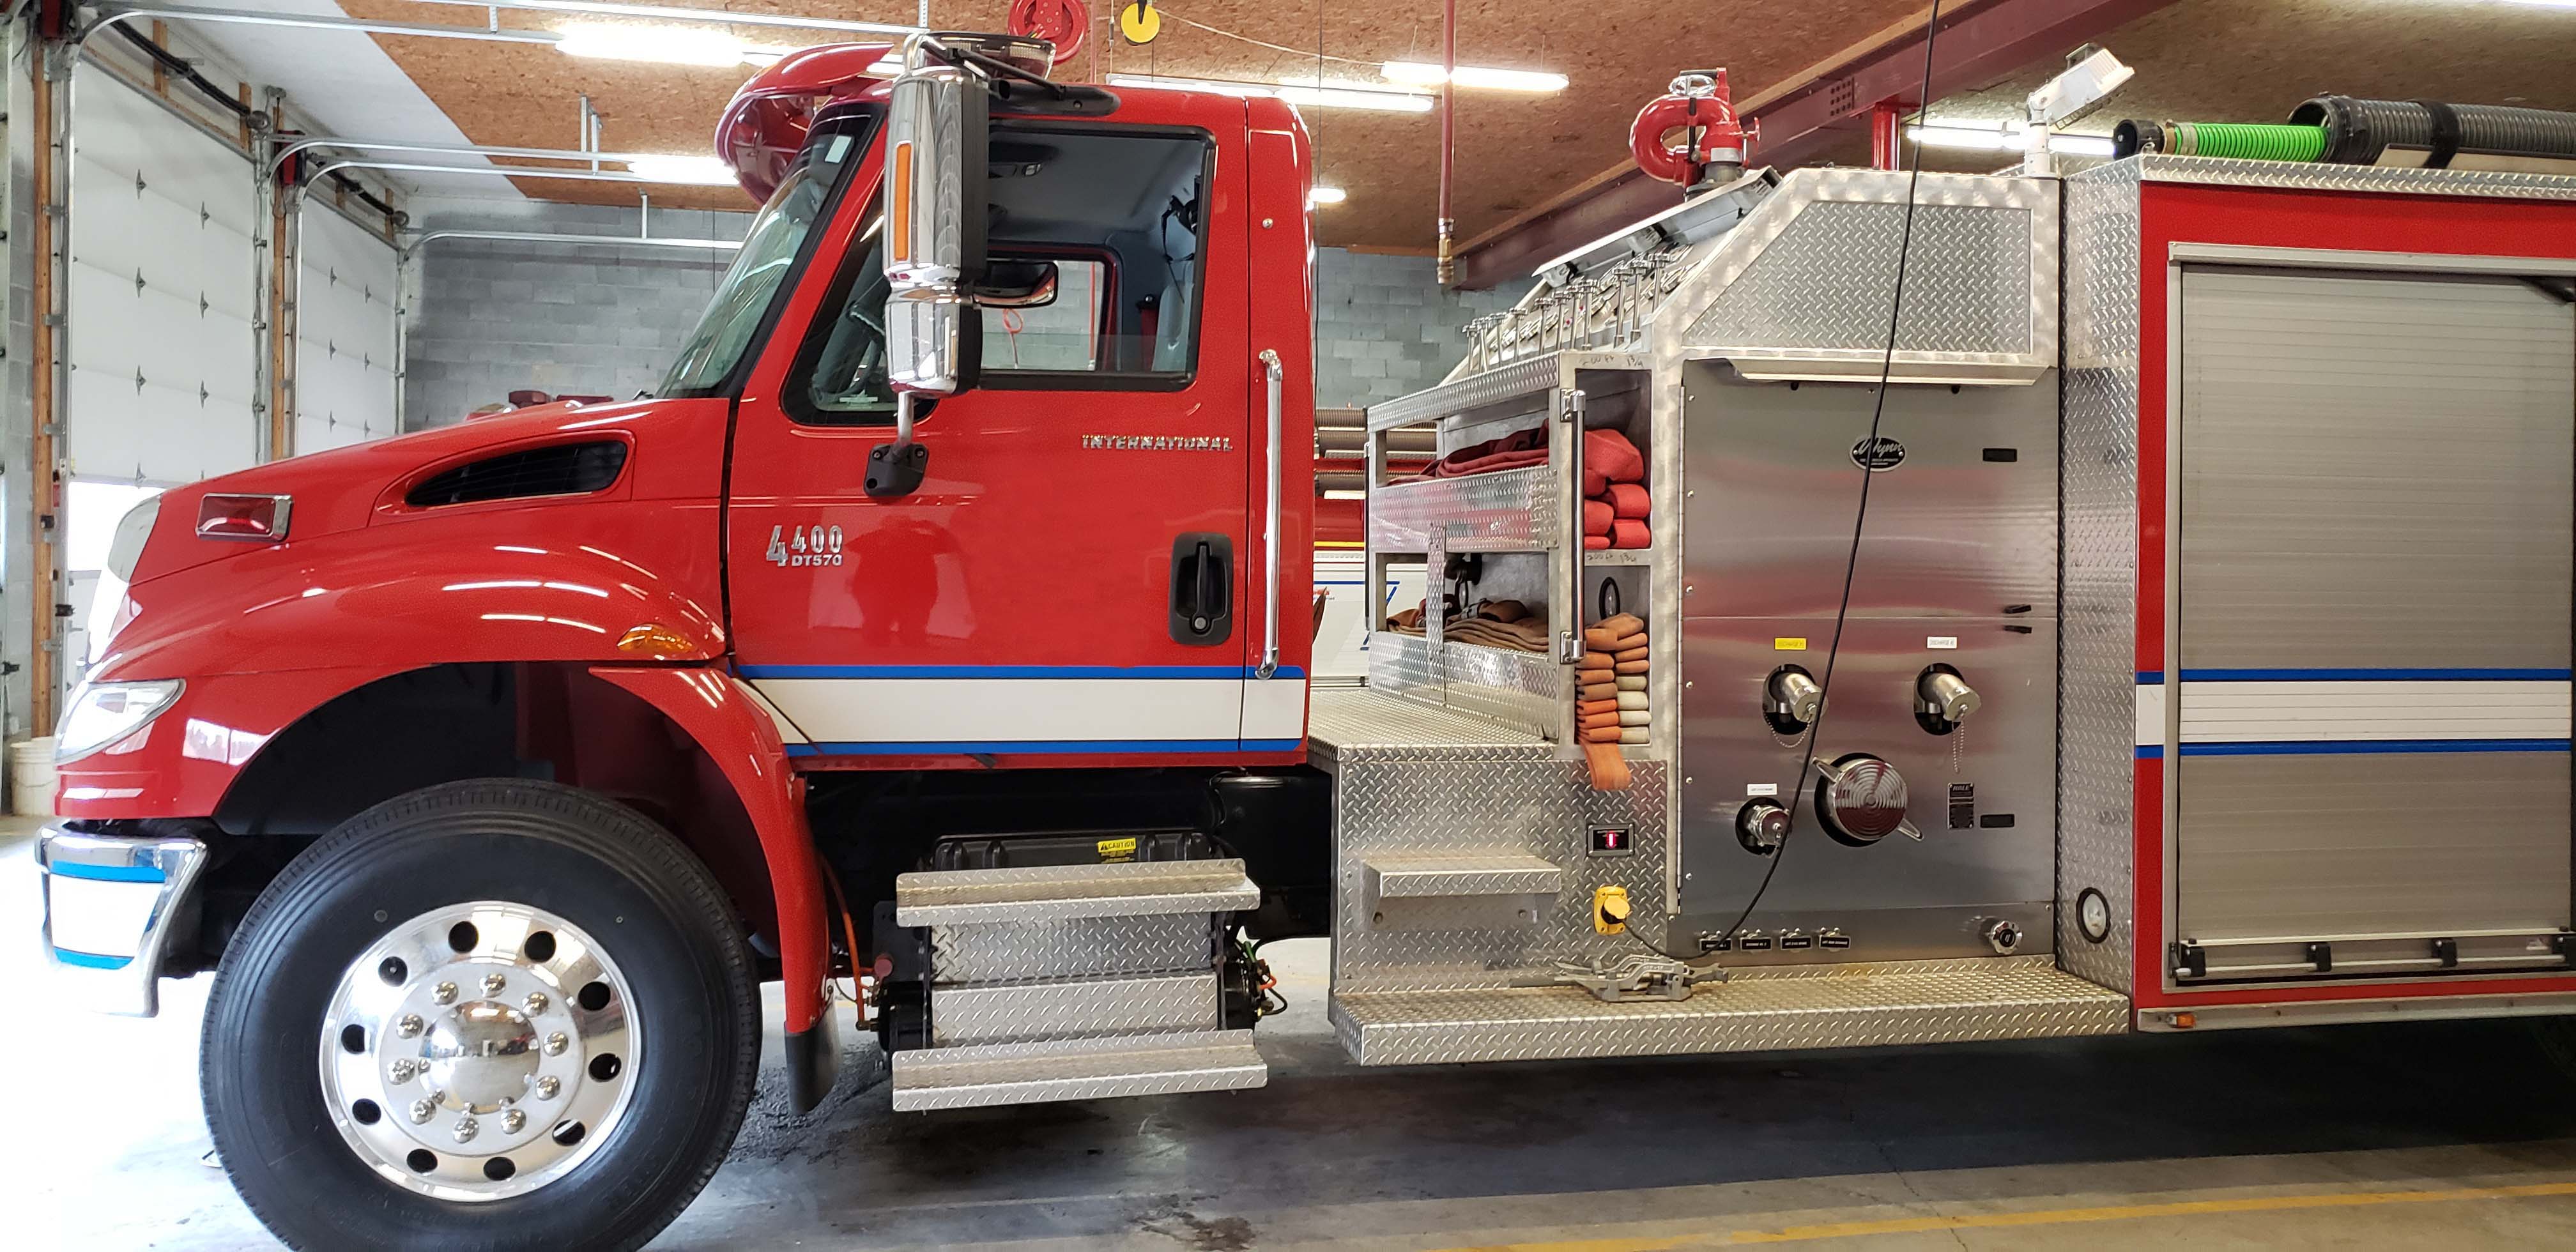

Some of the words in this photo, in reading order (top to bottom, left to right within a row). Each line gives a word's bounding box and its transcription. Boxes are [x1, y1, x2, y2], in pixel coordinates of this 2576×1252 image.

[1082, 434, 1233, 451] INTERNATIONAL
[766, 524, 843, 567] 4400
[791, 554, 843, 567] DT570
[1108, 841, 1135, 849] CAUTION
